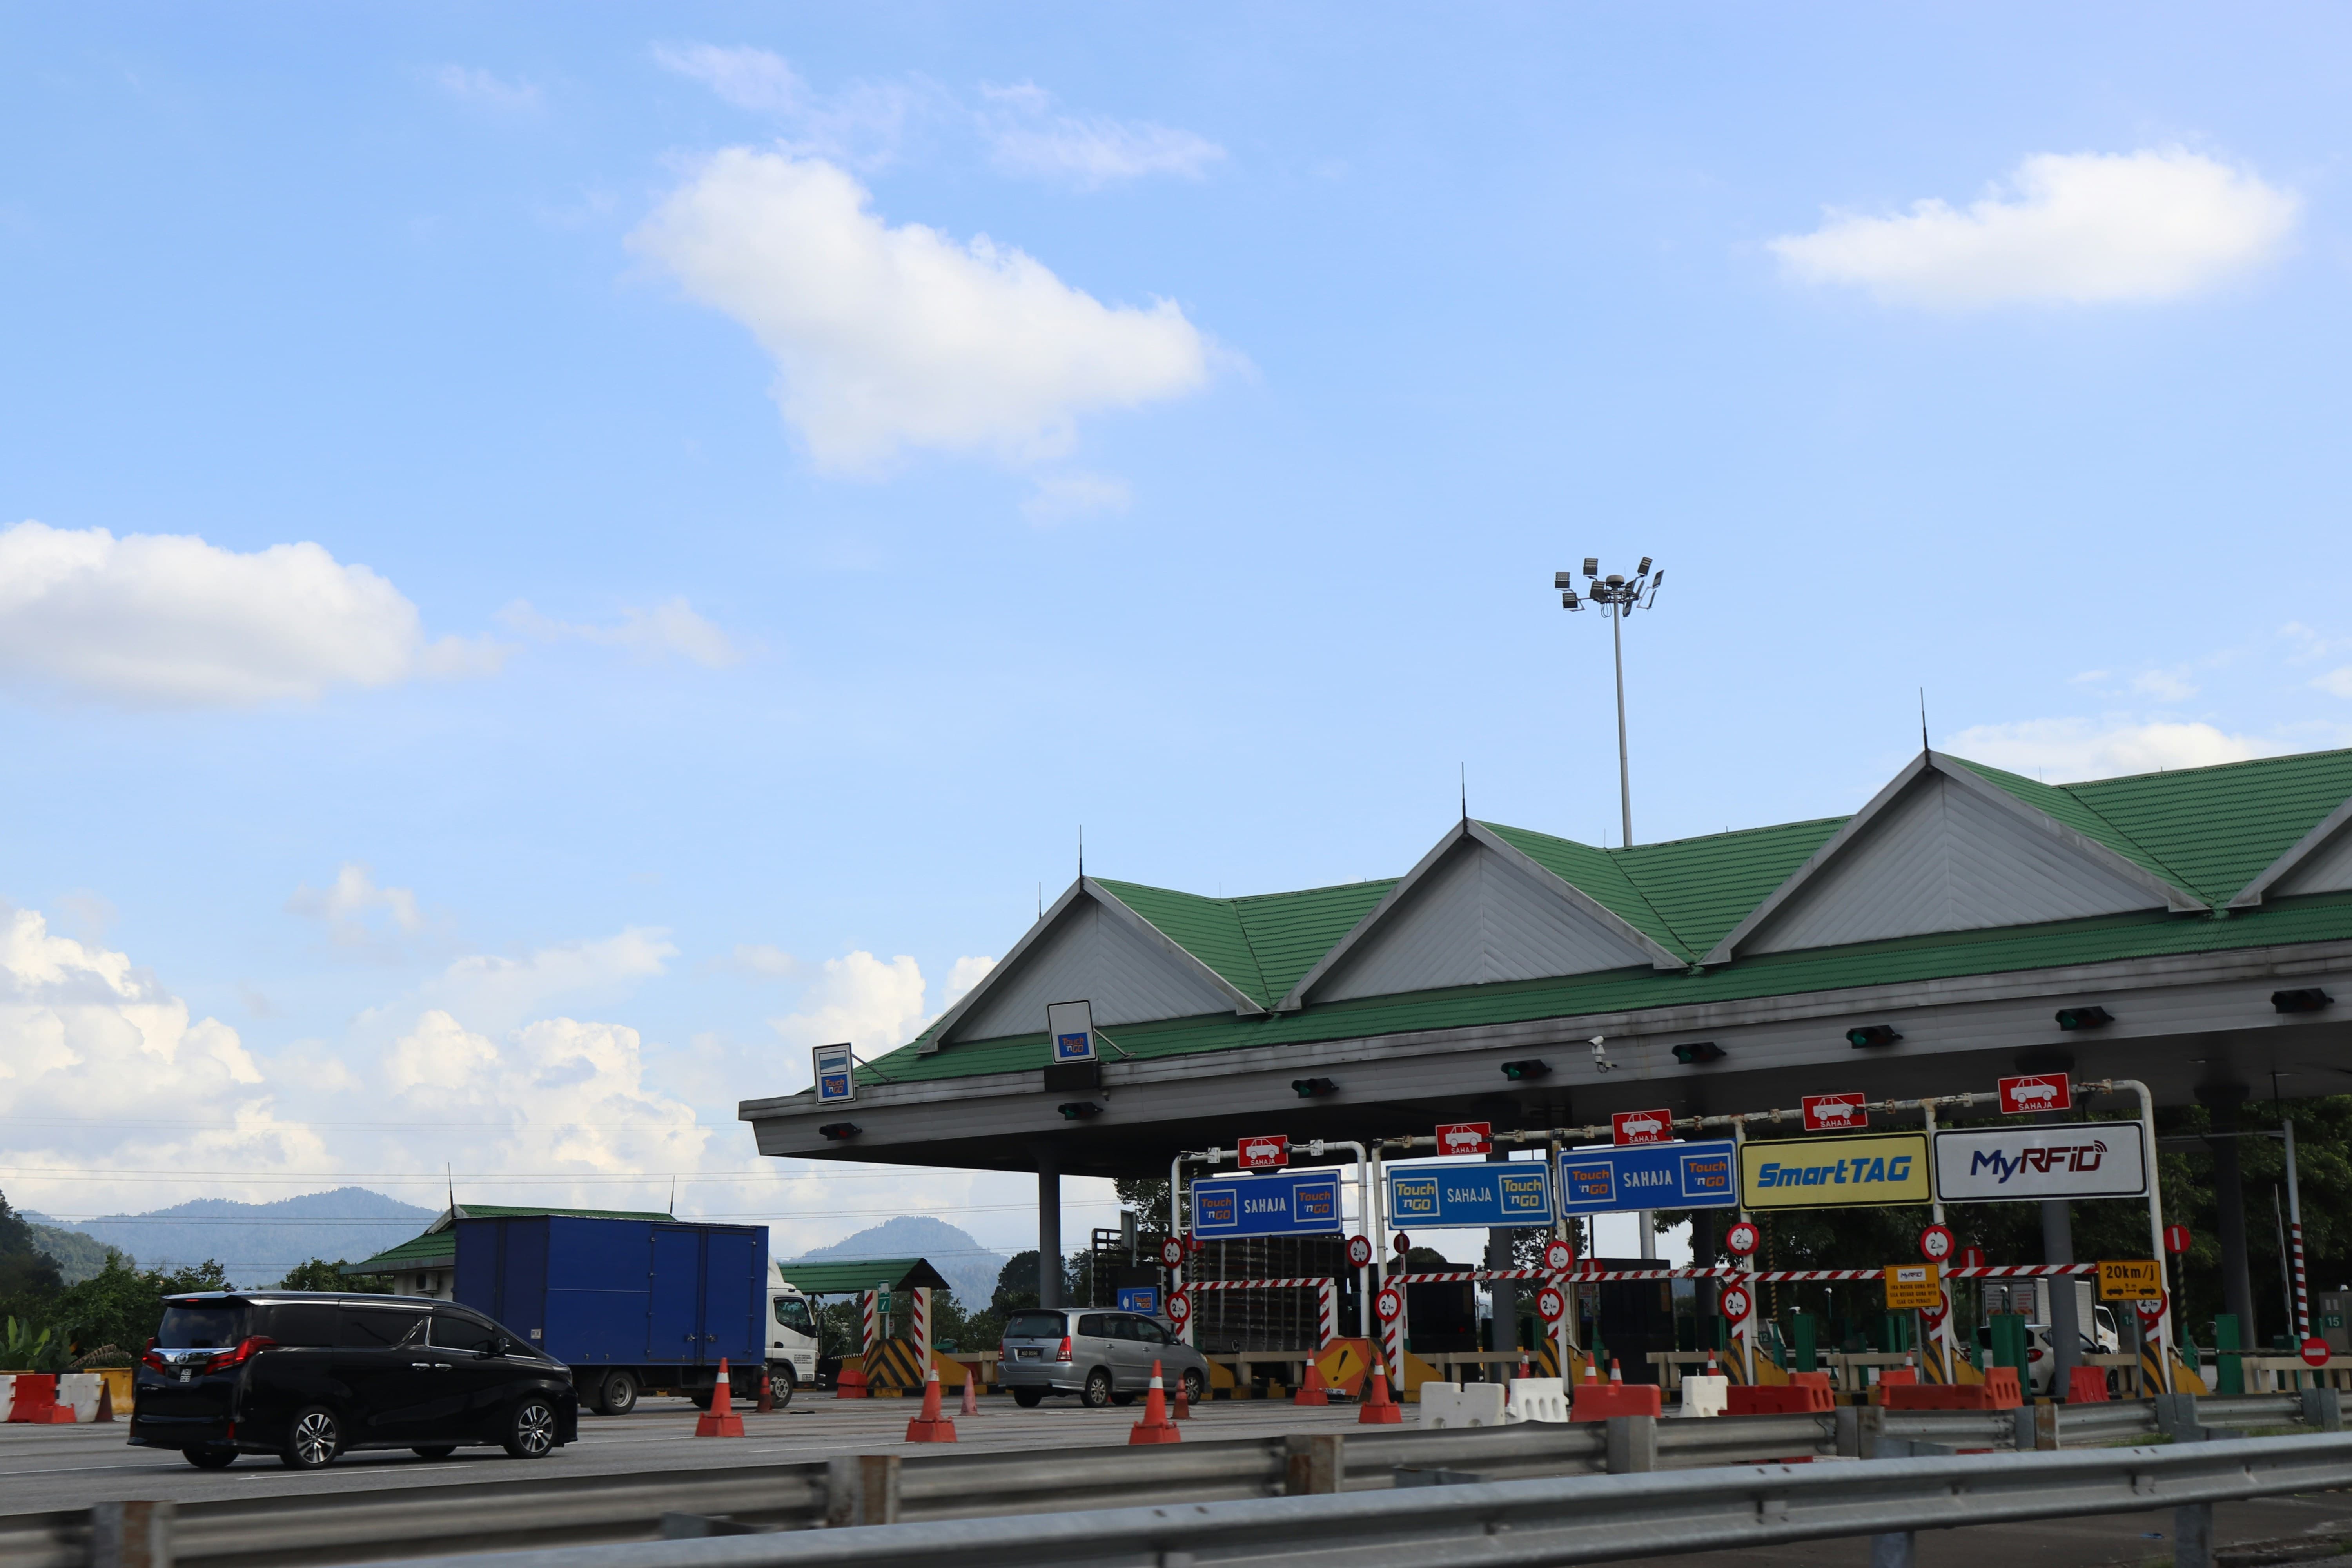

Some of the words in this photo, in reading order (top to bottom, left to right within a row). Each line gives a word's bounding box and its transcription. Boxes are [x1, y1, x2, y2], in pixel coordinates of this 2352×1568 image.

[1062, 1036, 1084, 1045] Touch
[825, 1078, 844, 1087] Touch
[2018, 1101, 2053, 1111] SAHAJA
[1820, 1120, 1852, 1128] SAHAJA
[1629, 1134, 1659, 1143] SAHAJA
[1689, 1161, 1726, 1172] Touch
[1572, 1169, 1609, 1181] Touch
[1757, 1156, 1912, 1188] SmartTAG
[1623, 1170, 1673, 1188] SAHAJA
[1396, 1183, 1435, 1196] Touch
[1503, 1179, 1542, 1192] Touch
[1299, 1191, 1331, 1201] Touch
[1447, 1187, 1492, 1203] SAHAJA
[1201, 1198, 1232, 1207] Touch
[1244, 1198, 1286, 1214] SAHAJA
[2106, 1265, 2154, 1281] 20km/j
[2327, 1317, 2339, 1327] 15
[1759, 1333, 1769, 1342] 12
